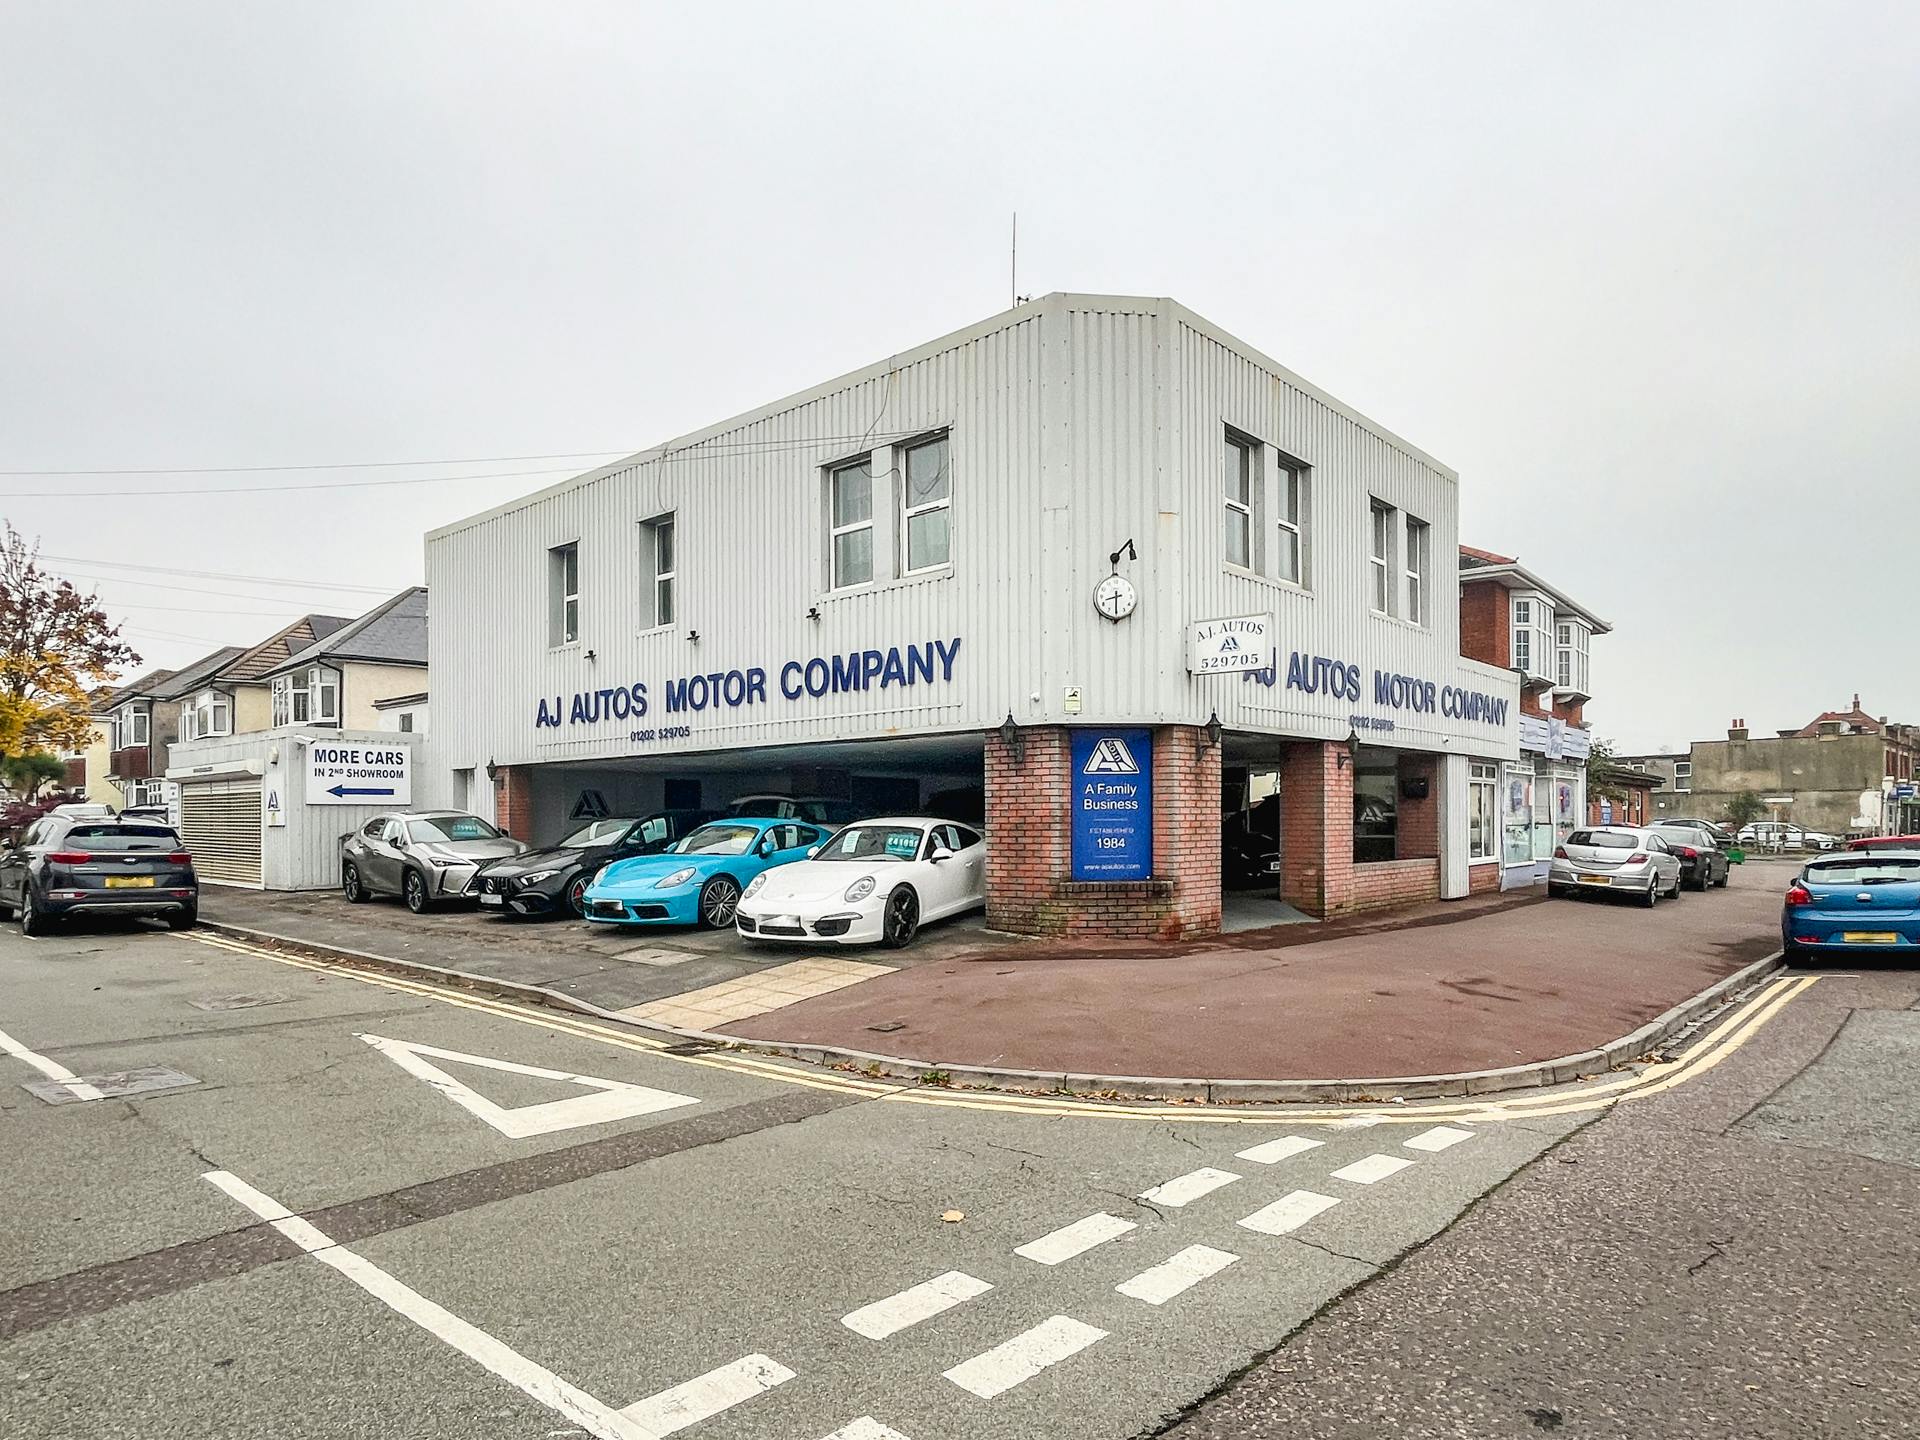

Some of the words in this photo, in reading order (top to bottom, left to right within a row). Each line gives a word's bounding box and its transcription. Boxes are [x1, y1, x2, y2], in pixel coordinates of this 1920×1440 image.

[1220, 621, 1265, 636] AUTOS
[1201, 653, 1259, 669] 529705
[536, 695, 562, 728] AJ
[570, 683, 648, 725] AUTOS
[666, 667, 767, 713] MOTOR
[780, 637, 962, 701] COMPANY
[1286, 651, 1361, 702] AUTOS
[1374, 669, 1437, 714] MOTOR
[1441, 684, 1509, 727] COMPANY
[630, 729, 655, 742] 01202
[658, 725, 690, 740] 529705
[314, 748, 360, 764] MORE
[364, 751, 404, 765] CARS
[314, 767, 325, 777] IN
[346, 768, 404, 779] SHOWROOM
[1085, 783, 1095, 795] A
[1097, 783, 1137, 797] Family
[1083, 798, 1139, 810] Business
[1097, 837, 1126, 849] 1984
